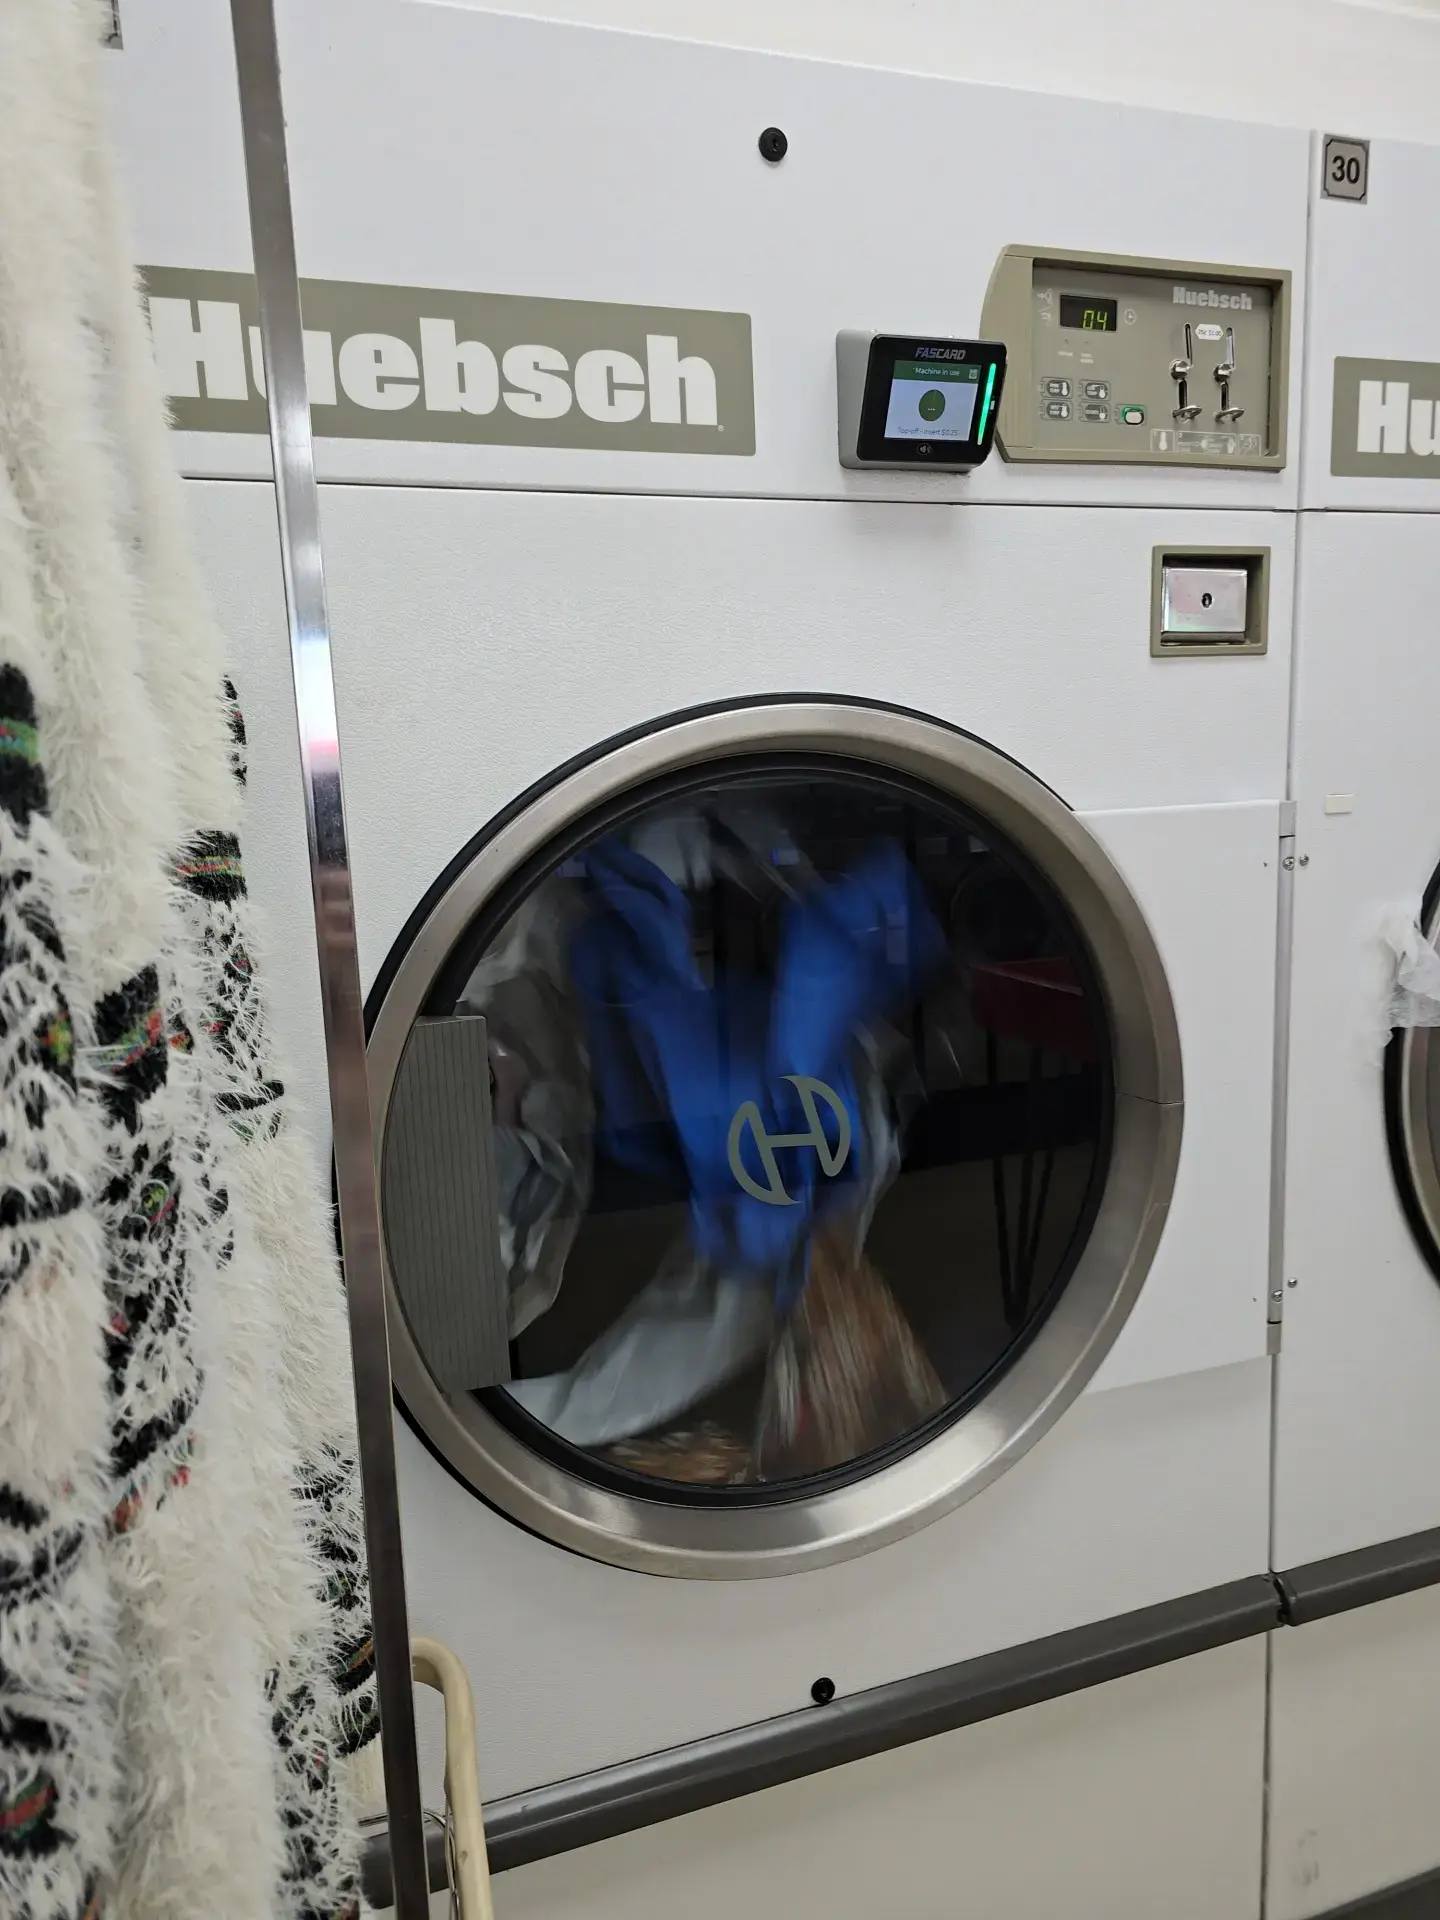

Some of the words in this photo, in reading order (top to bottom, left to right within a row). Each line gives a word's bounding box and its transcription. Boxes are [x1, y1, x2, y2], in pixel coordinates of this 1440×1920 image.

[1331, 155, 1361, 184] 30
[1172, 286, 1252, 310] Huebsch
[1083, 310, 1108, 330] 04
[915, 347, 966, 360] FASCARD
[915, 366, 941, 376] Machine
[941, 368, 949, 376] in
